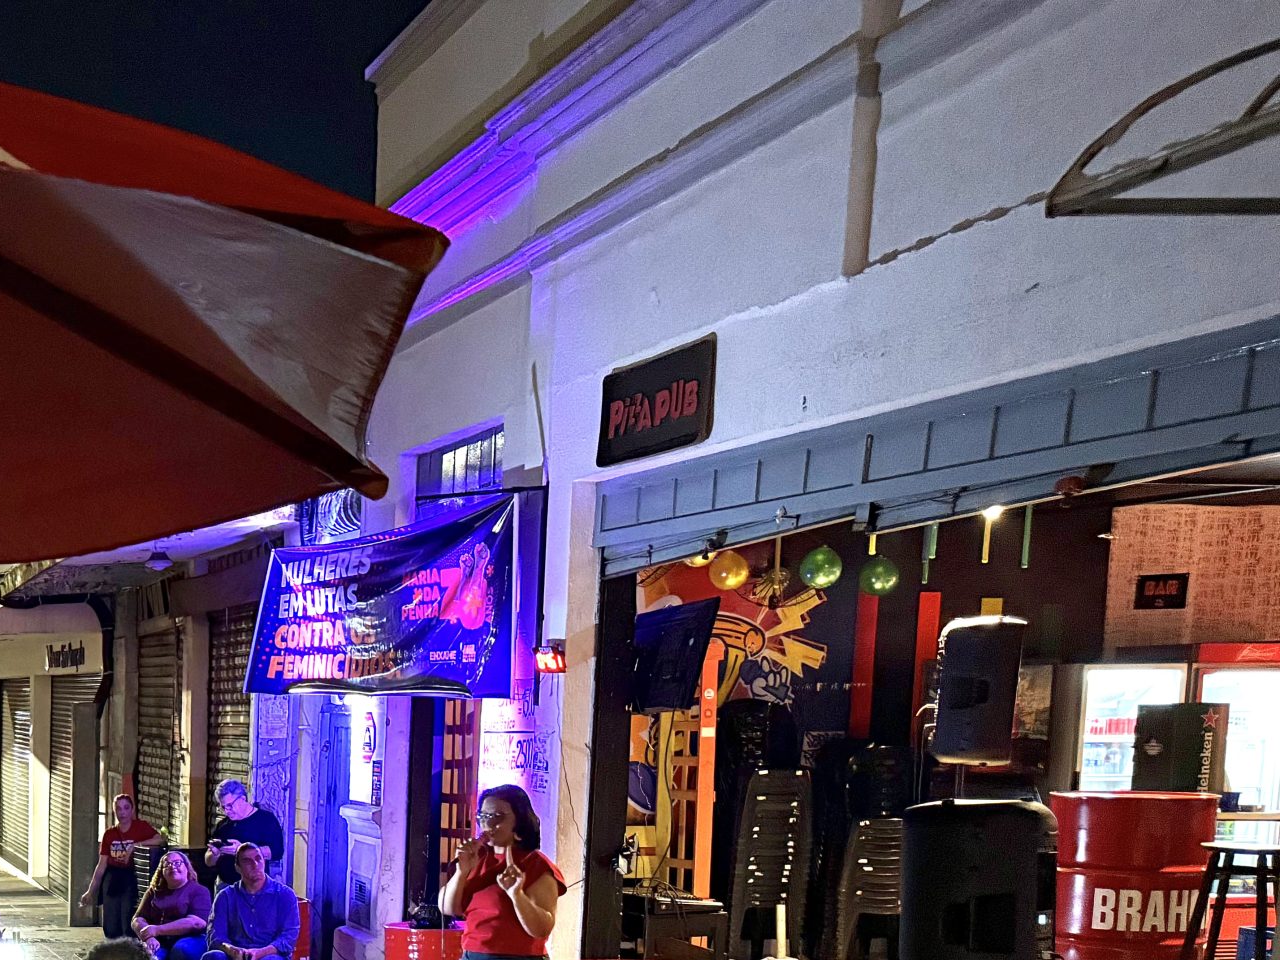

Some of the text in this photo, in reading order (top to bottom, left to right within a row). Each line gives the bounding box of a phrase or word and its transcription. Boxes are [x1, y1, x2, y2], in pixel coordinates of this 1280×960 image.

[653, 379, 699, 427] PUB
[280, 549, 373, 588] MULHERES
[279, 584, 359, 618] EM LUTAS
[423, 585, 440, 602] DA
[402, 603, 440, 621] PENHA
[274, 619, 347, 649] CONTRA
